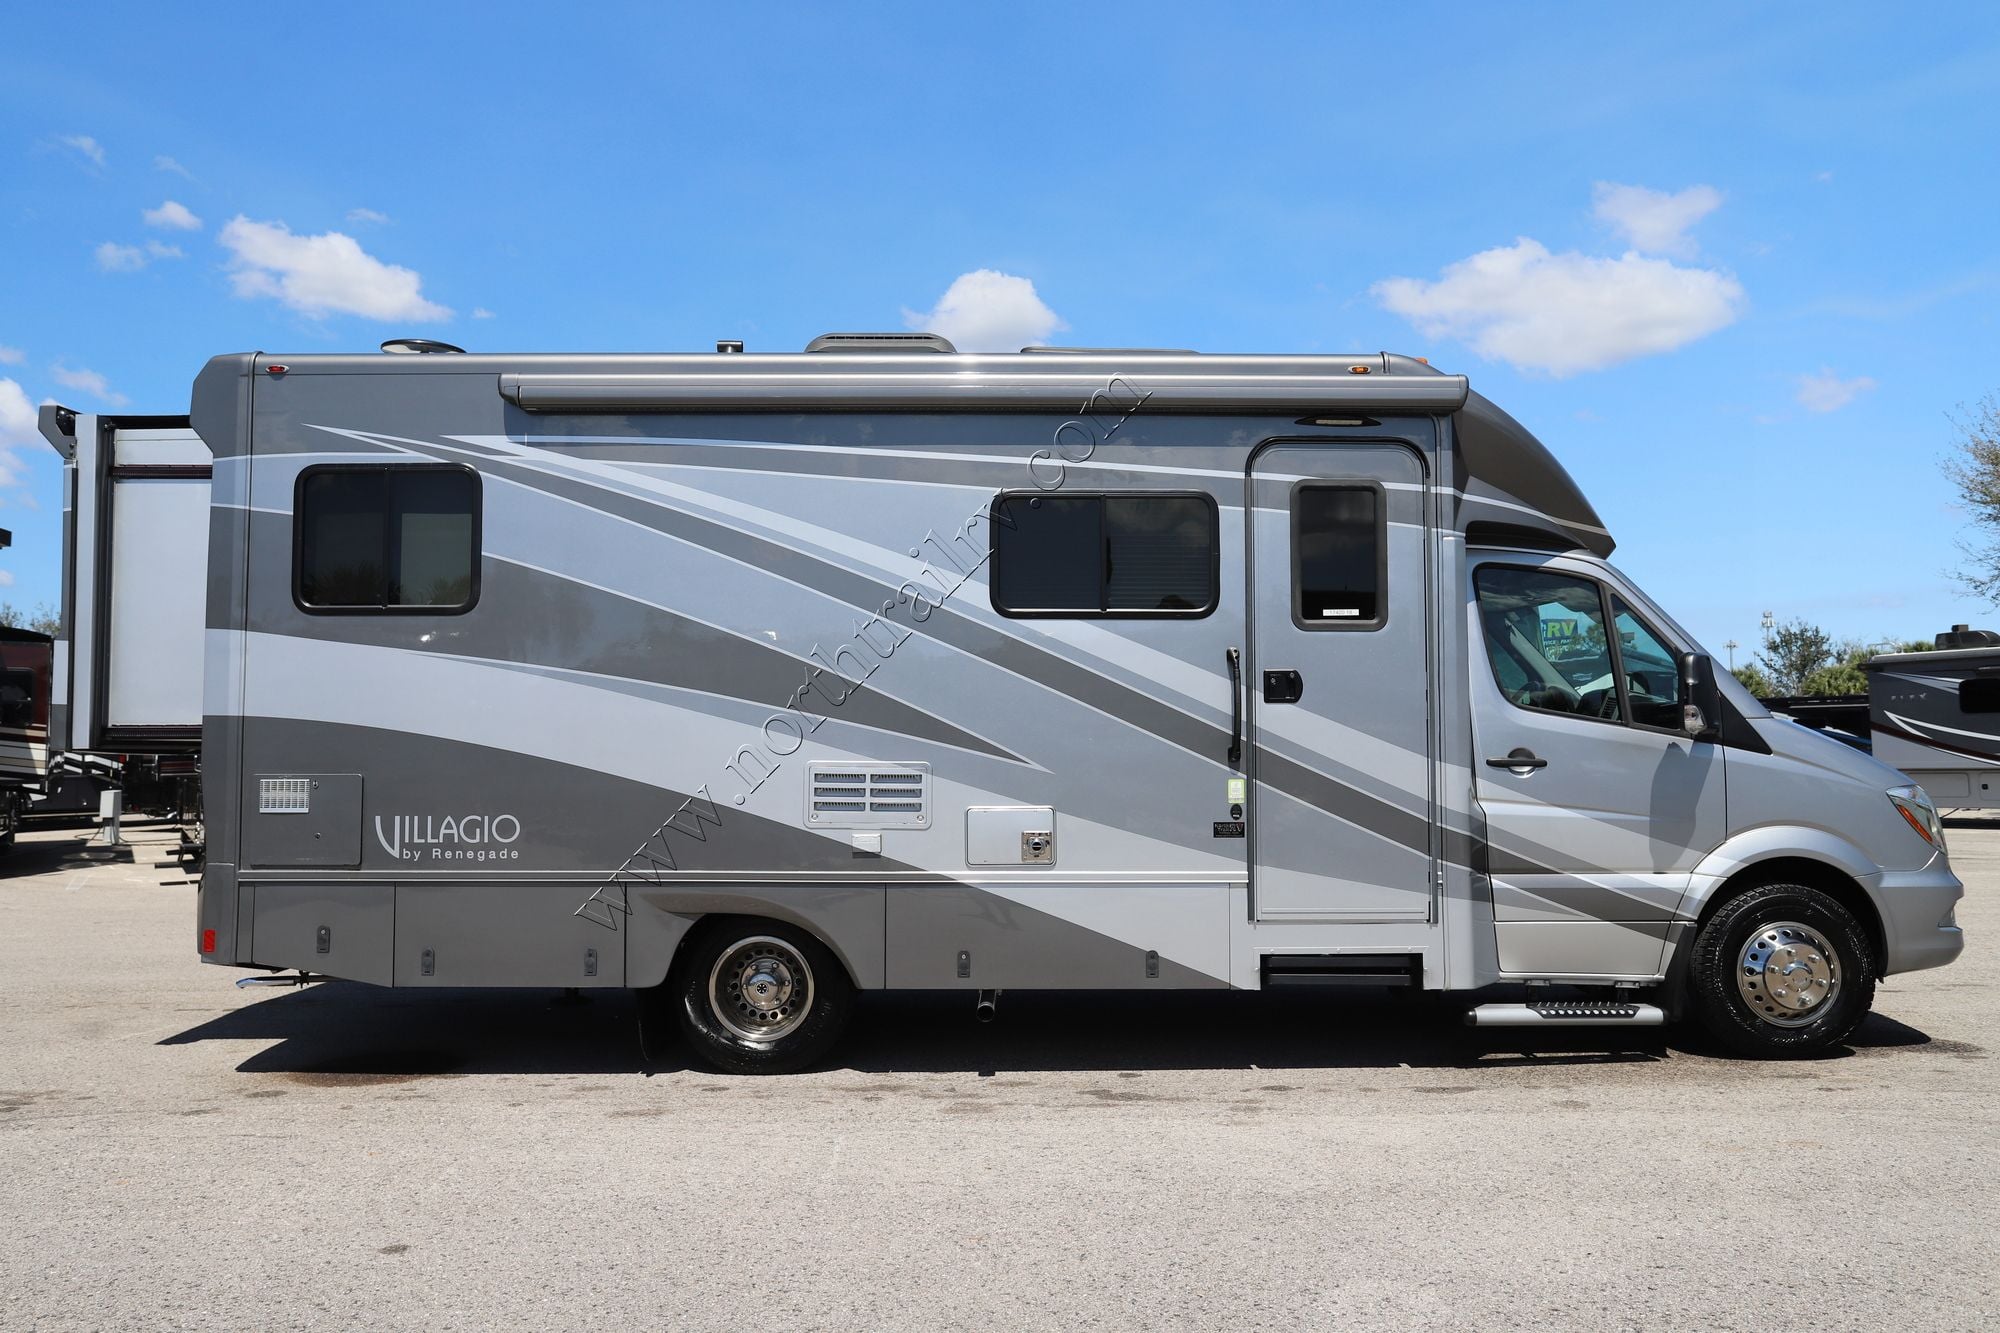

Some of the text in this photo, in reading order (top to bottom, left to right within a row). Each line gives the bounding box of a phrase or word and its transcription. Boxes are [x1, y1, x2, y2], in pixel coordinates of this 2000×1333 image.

[1547, 622, 1575, 638] RV
[375, 814, 521, 858] VILLAGIO
[403, 848, 519, 861] by Renegade
